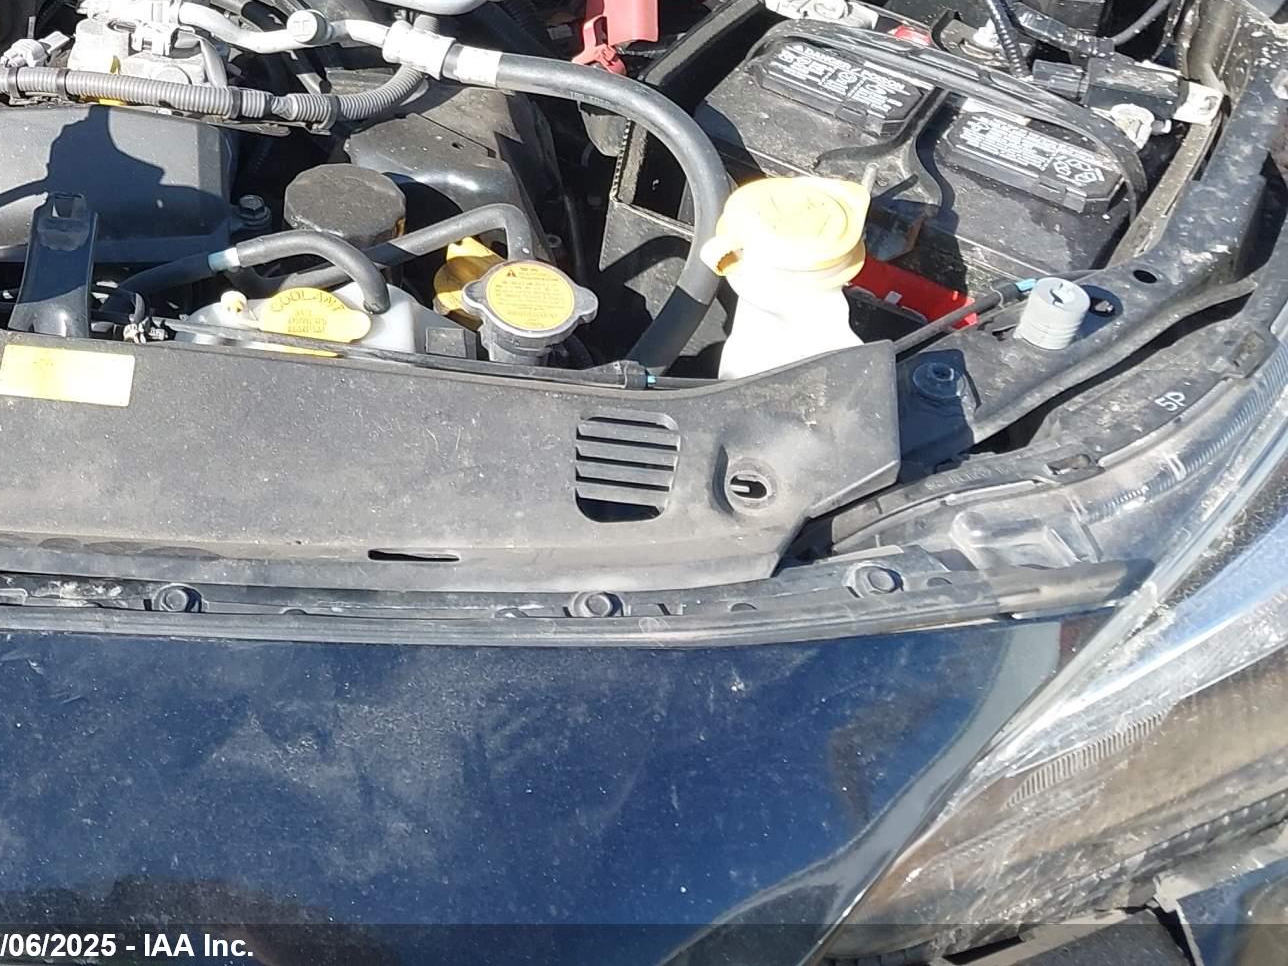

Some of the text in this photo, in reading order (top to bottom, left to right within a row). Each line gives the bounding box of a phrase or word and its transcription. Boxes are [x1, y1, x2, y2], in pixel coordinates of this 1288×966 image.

[806, 46, 852, 71] DANGER
[272, 290, 346, 313] COOLANT
[1154, 392, 1186, 412] 5P
